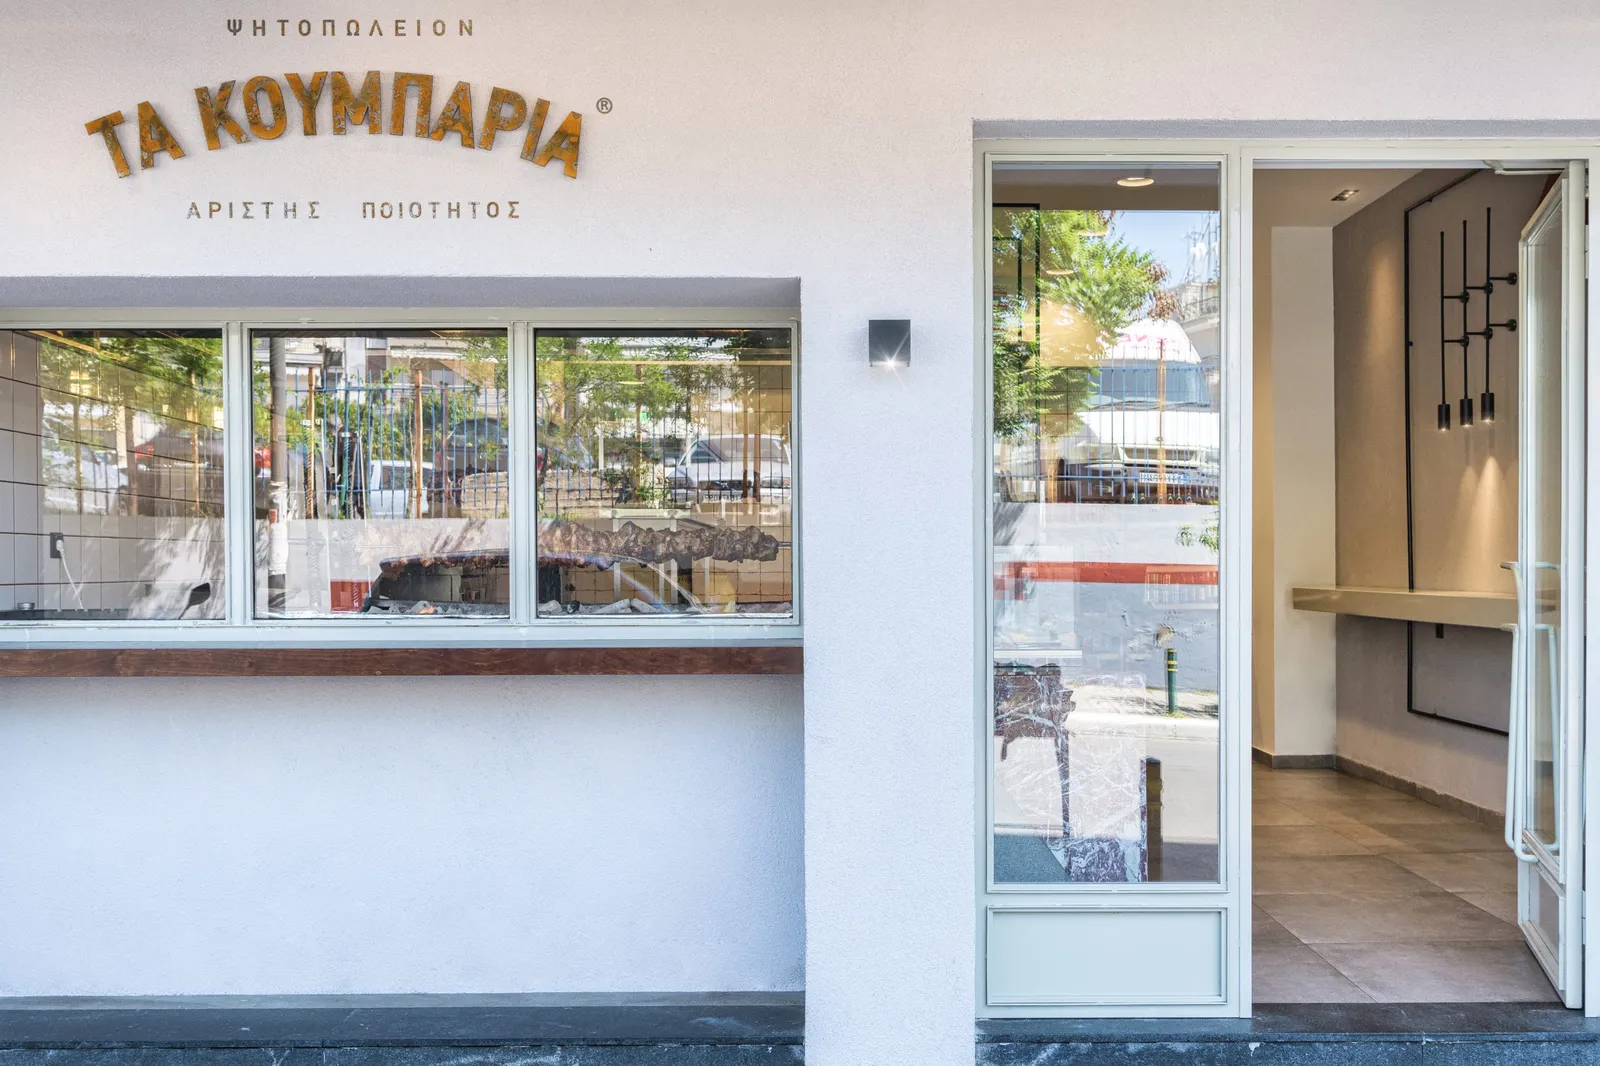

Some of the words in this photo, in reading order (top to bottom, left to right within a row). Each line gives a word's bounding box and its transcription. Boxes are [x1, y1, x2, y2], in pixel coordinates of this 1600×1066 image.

[227, 19, 475, 37] ΨΗΤΟΠΩΛΕΙΟΝ
[84, 101, 186, 179] ΤΑ
[194, 70, 583, 180] ΚΟΥΜΠΑΡΙΑ
[187, 201, 321, 219] ΑΡΙΣΤΗΣ
[362, 201, 521, 219] ΠΟΙΟΤΗΤΟΣ
